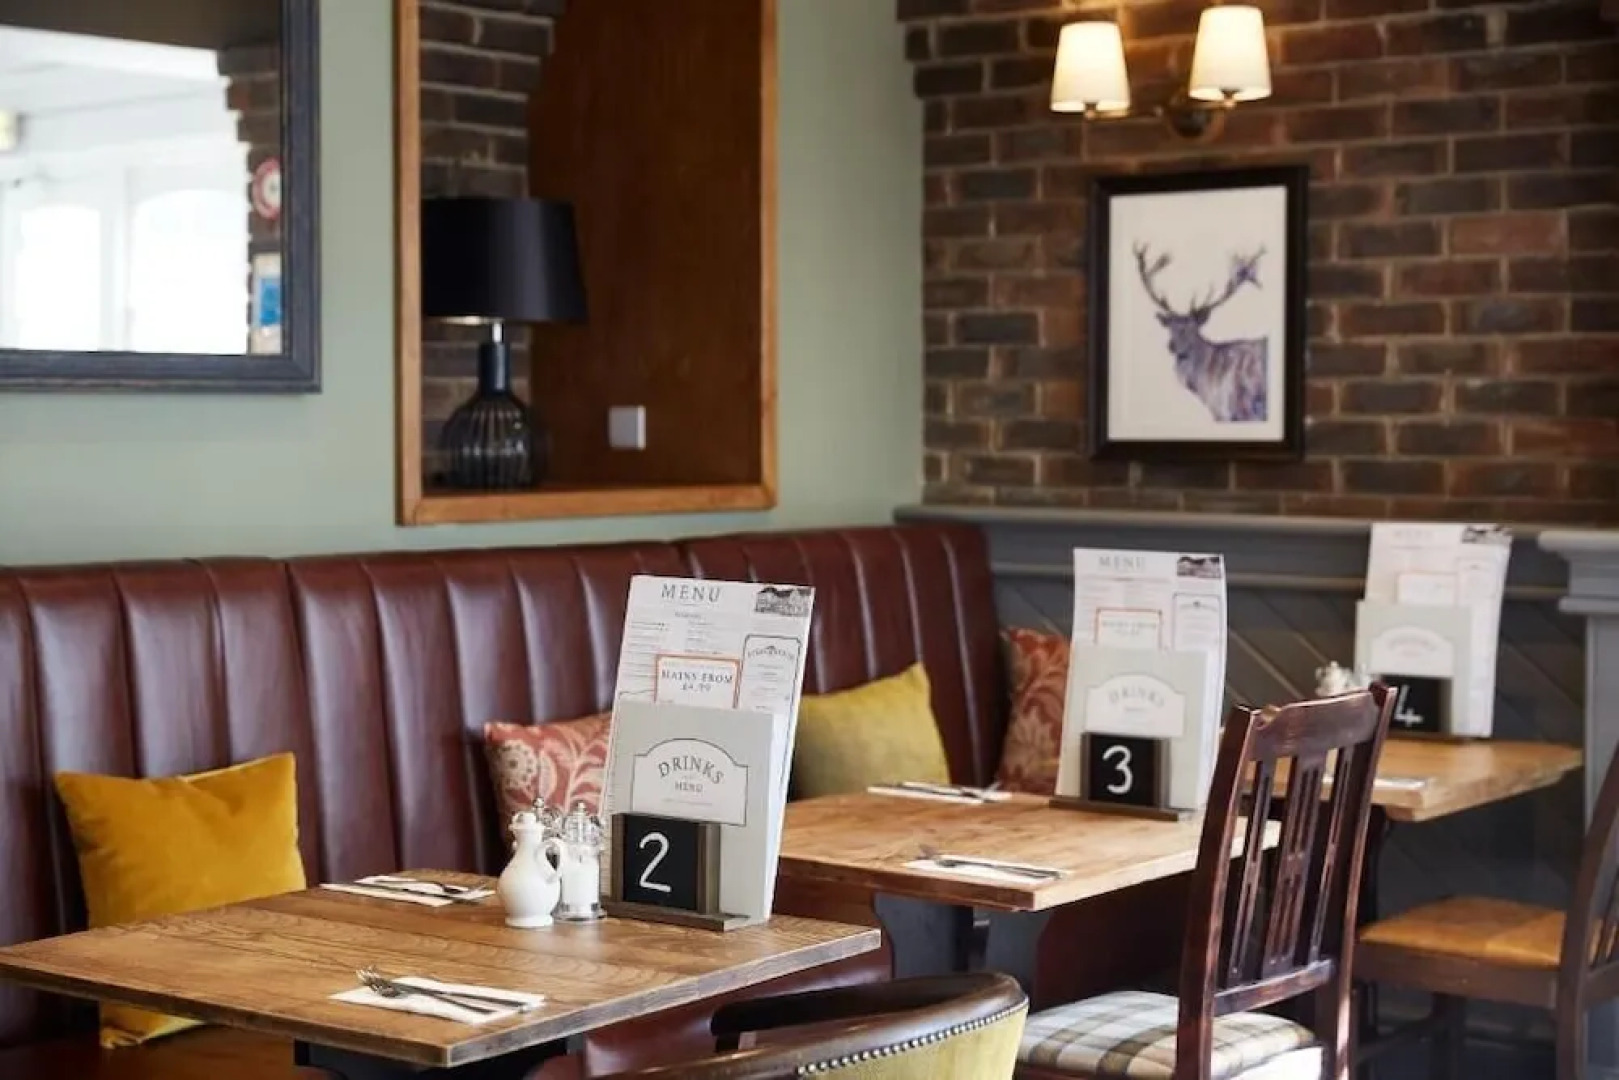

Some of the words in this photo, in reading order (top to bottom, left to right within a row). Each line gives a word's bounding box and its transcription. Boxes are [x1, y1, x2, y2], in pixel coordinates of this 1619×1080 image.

[661, 583, 721, 603] MENU
[661, 669, 697, 681] MAINS
[702, 672, 733, 683] FROM
[1393, 684, 1424, 727] 4
[658, 755, 724, 784] DRINKS
[1102, 744, 1133, 794] 3
[674, 781, 704, 793] MENU
[639, 831, 672, 893] 2
